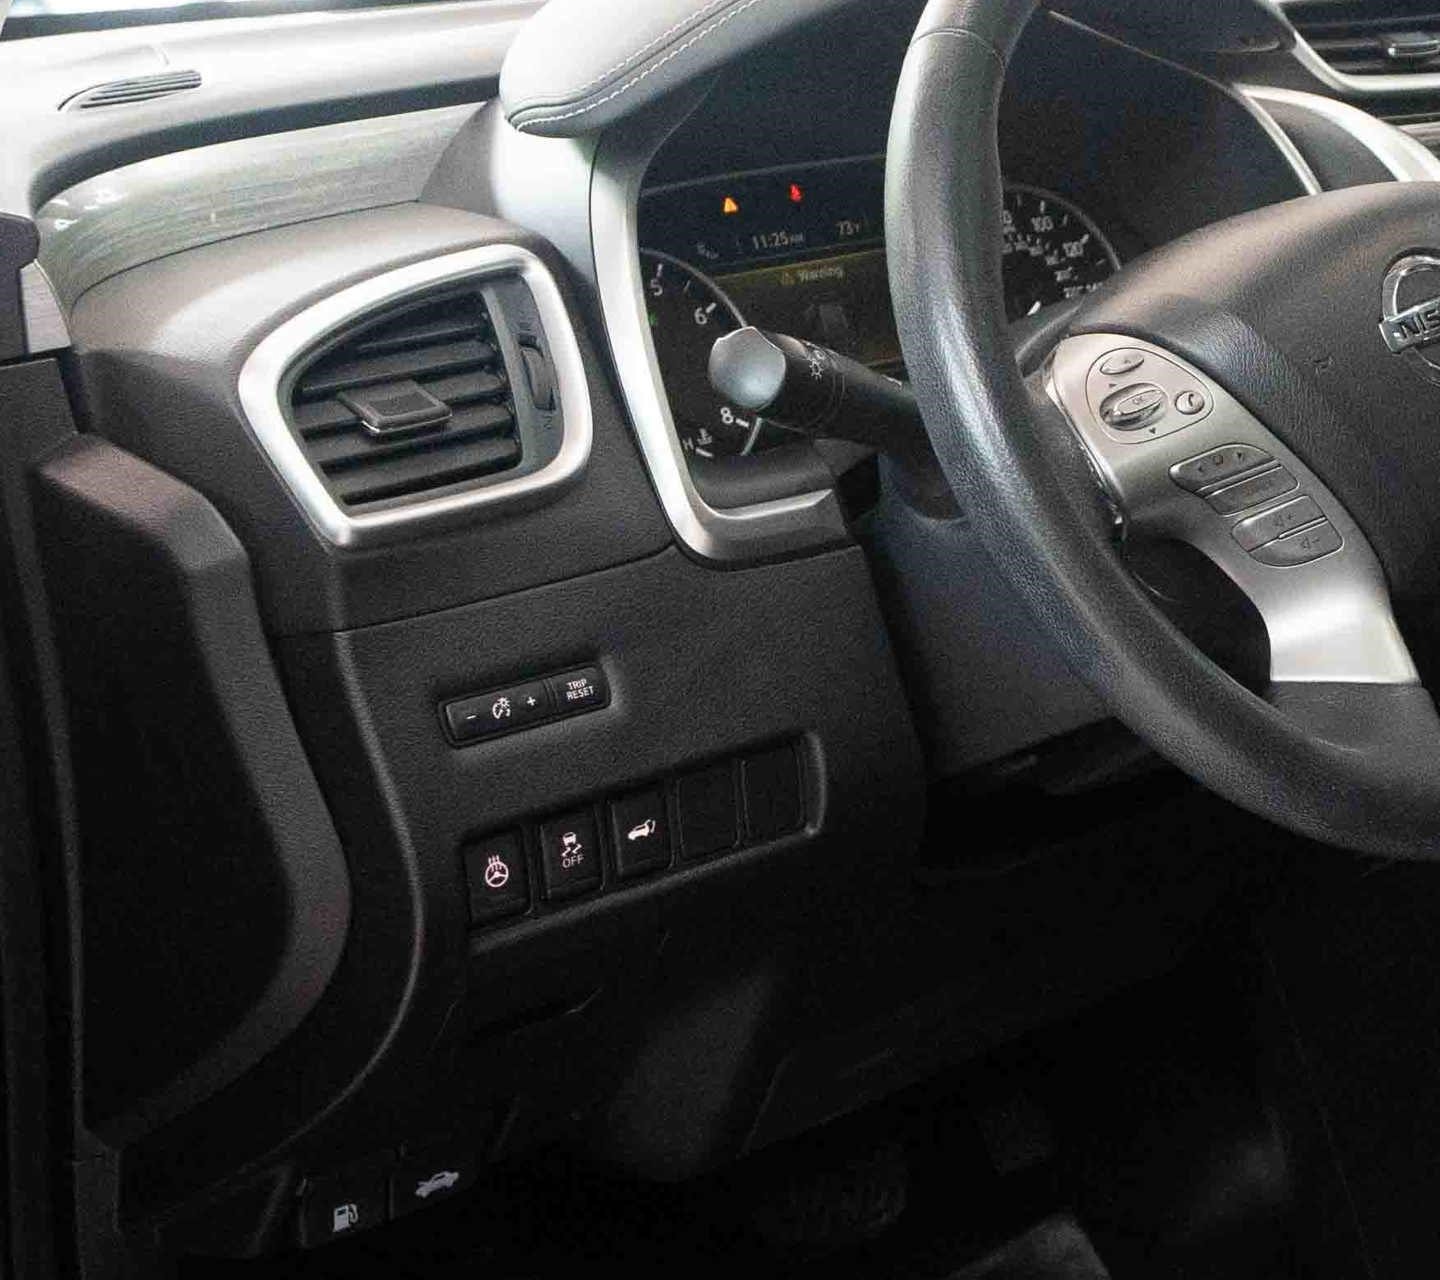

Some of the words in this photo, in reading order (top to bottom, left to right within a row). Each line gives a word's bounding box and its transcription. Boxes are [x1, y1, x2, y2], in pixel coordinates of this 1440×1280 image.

[650, 278, 663, 297] 5
[694, 307, 707, 325] 6
[720, 407, 734, 424] 8
[566, 678, 588, 691] TRIP
[566, 686, 595, 701] RESET
[562, 854, 585, 869] OFF
